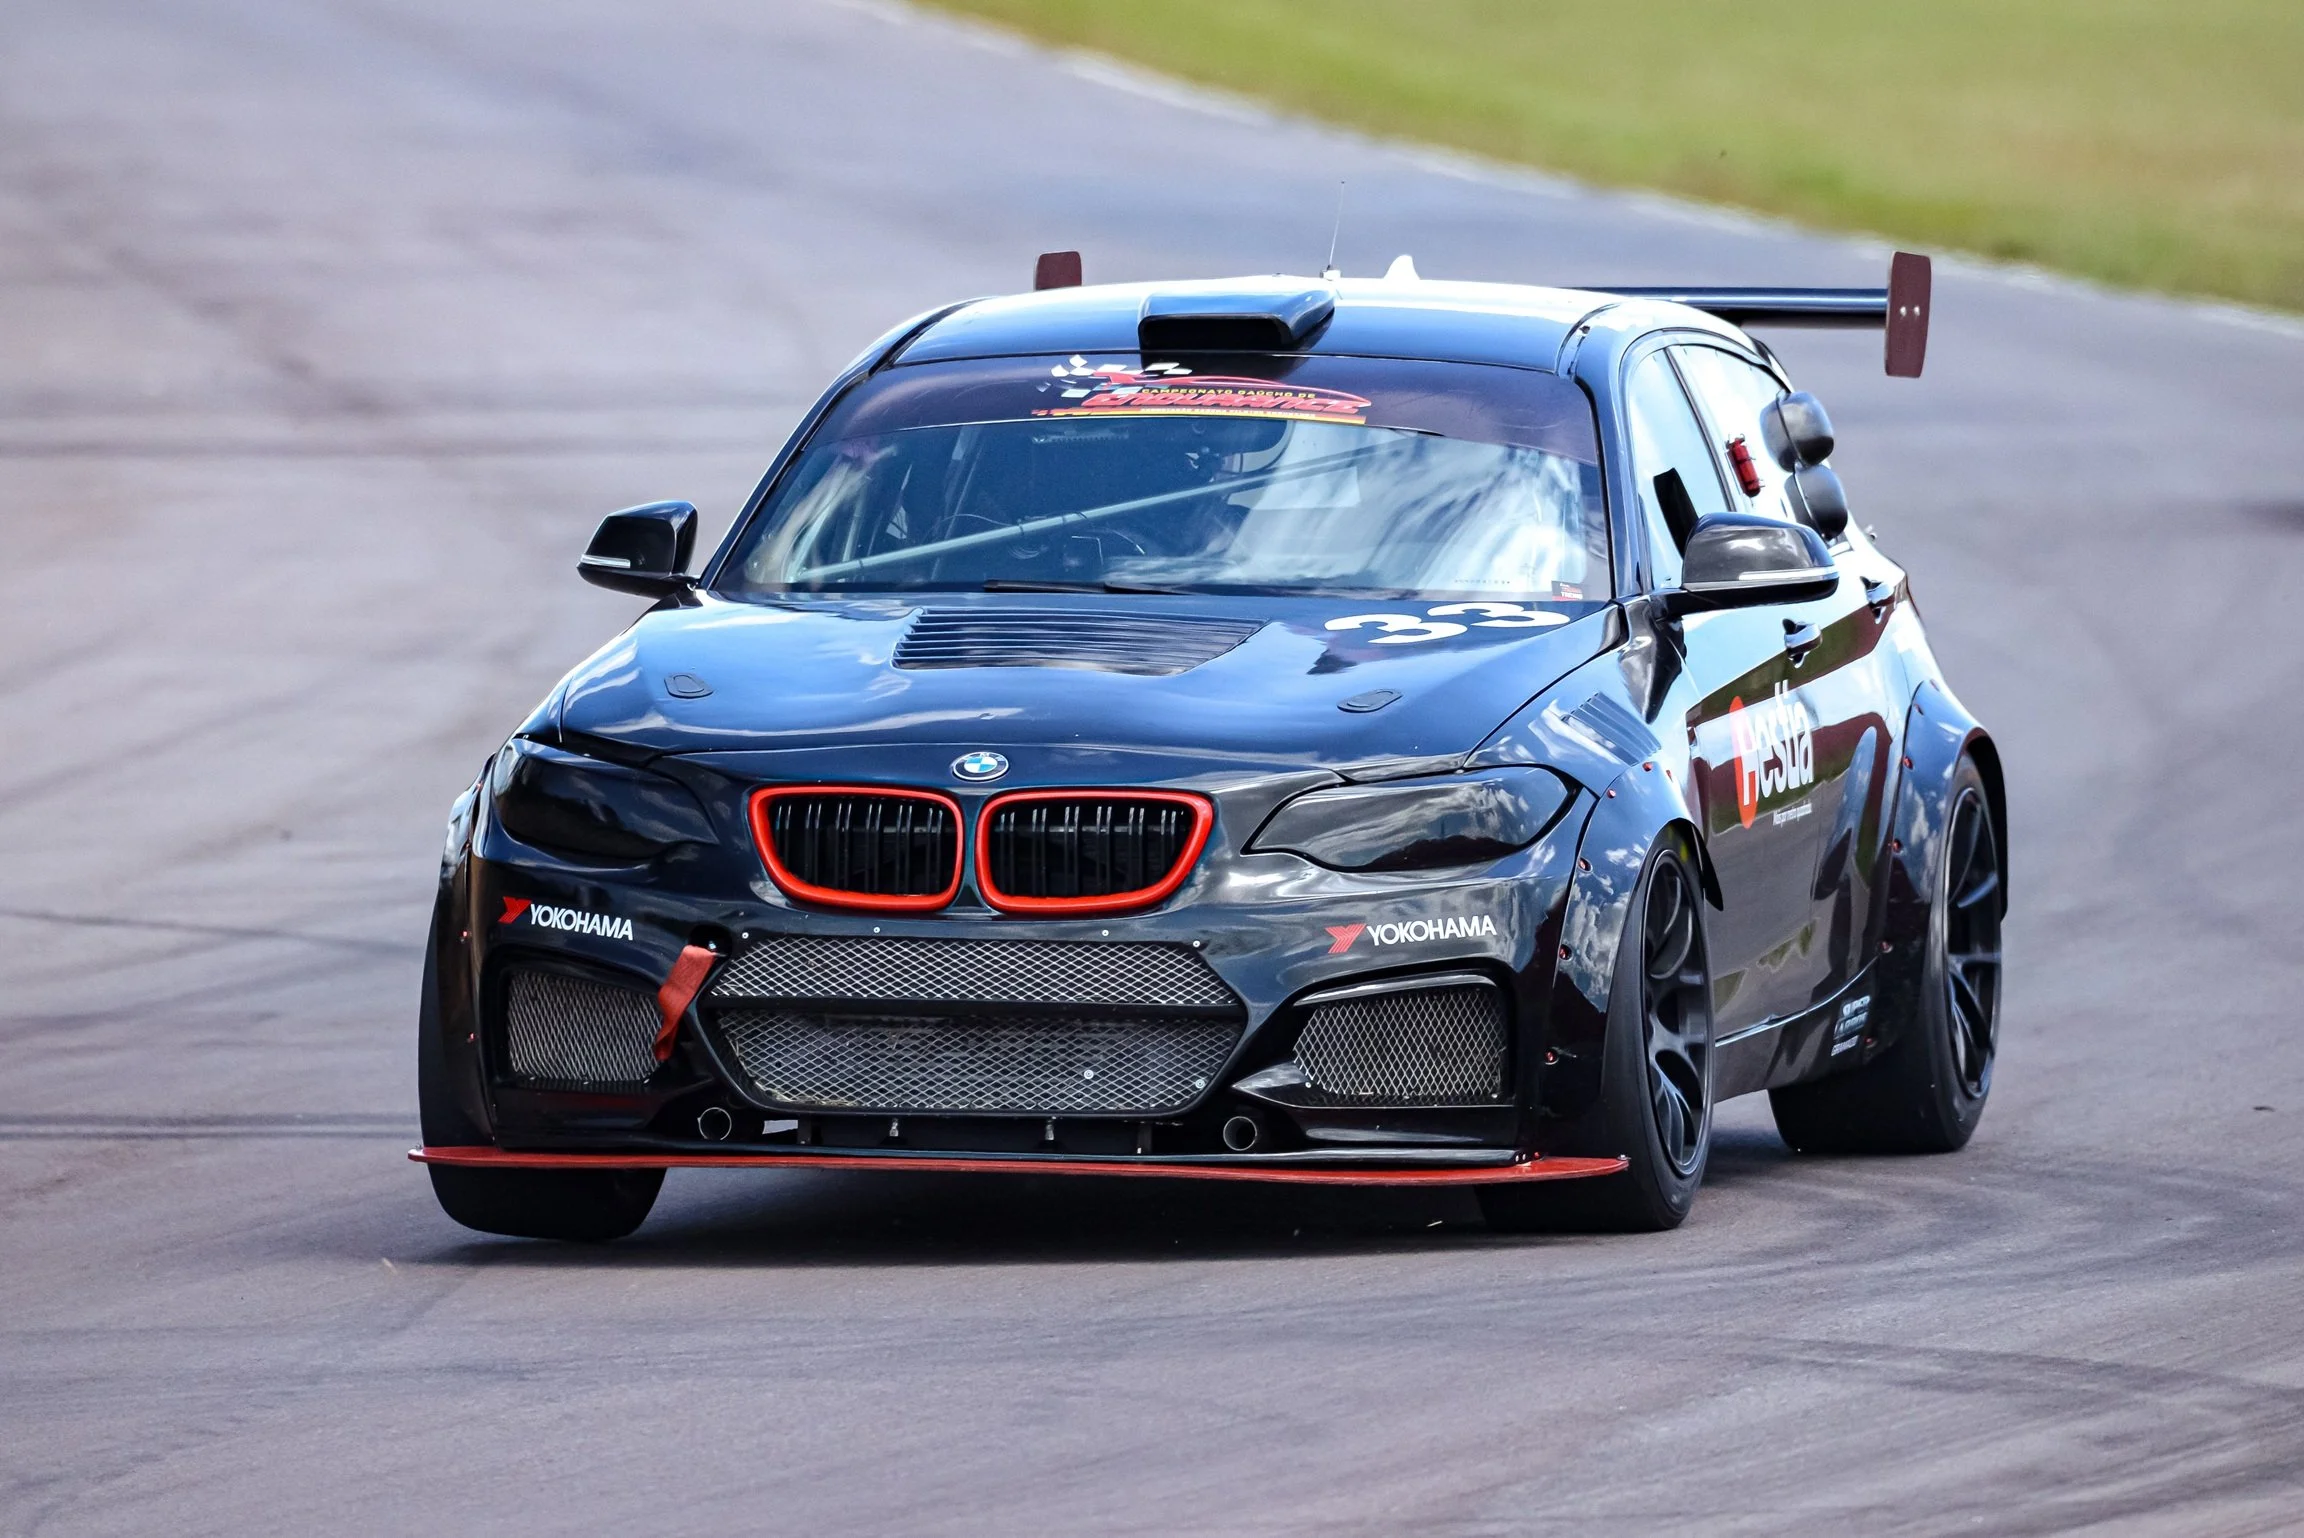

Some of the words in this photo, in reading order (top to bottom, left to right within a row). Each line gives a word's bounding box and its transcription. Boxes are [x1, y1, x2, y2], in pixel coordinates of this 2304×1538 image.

[1324, 602, 1571, 644] 33
[530, 903, 633, 941] YOKOHAMA
[1366, 915, 1498, 946] YOKOHAMA
